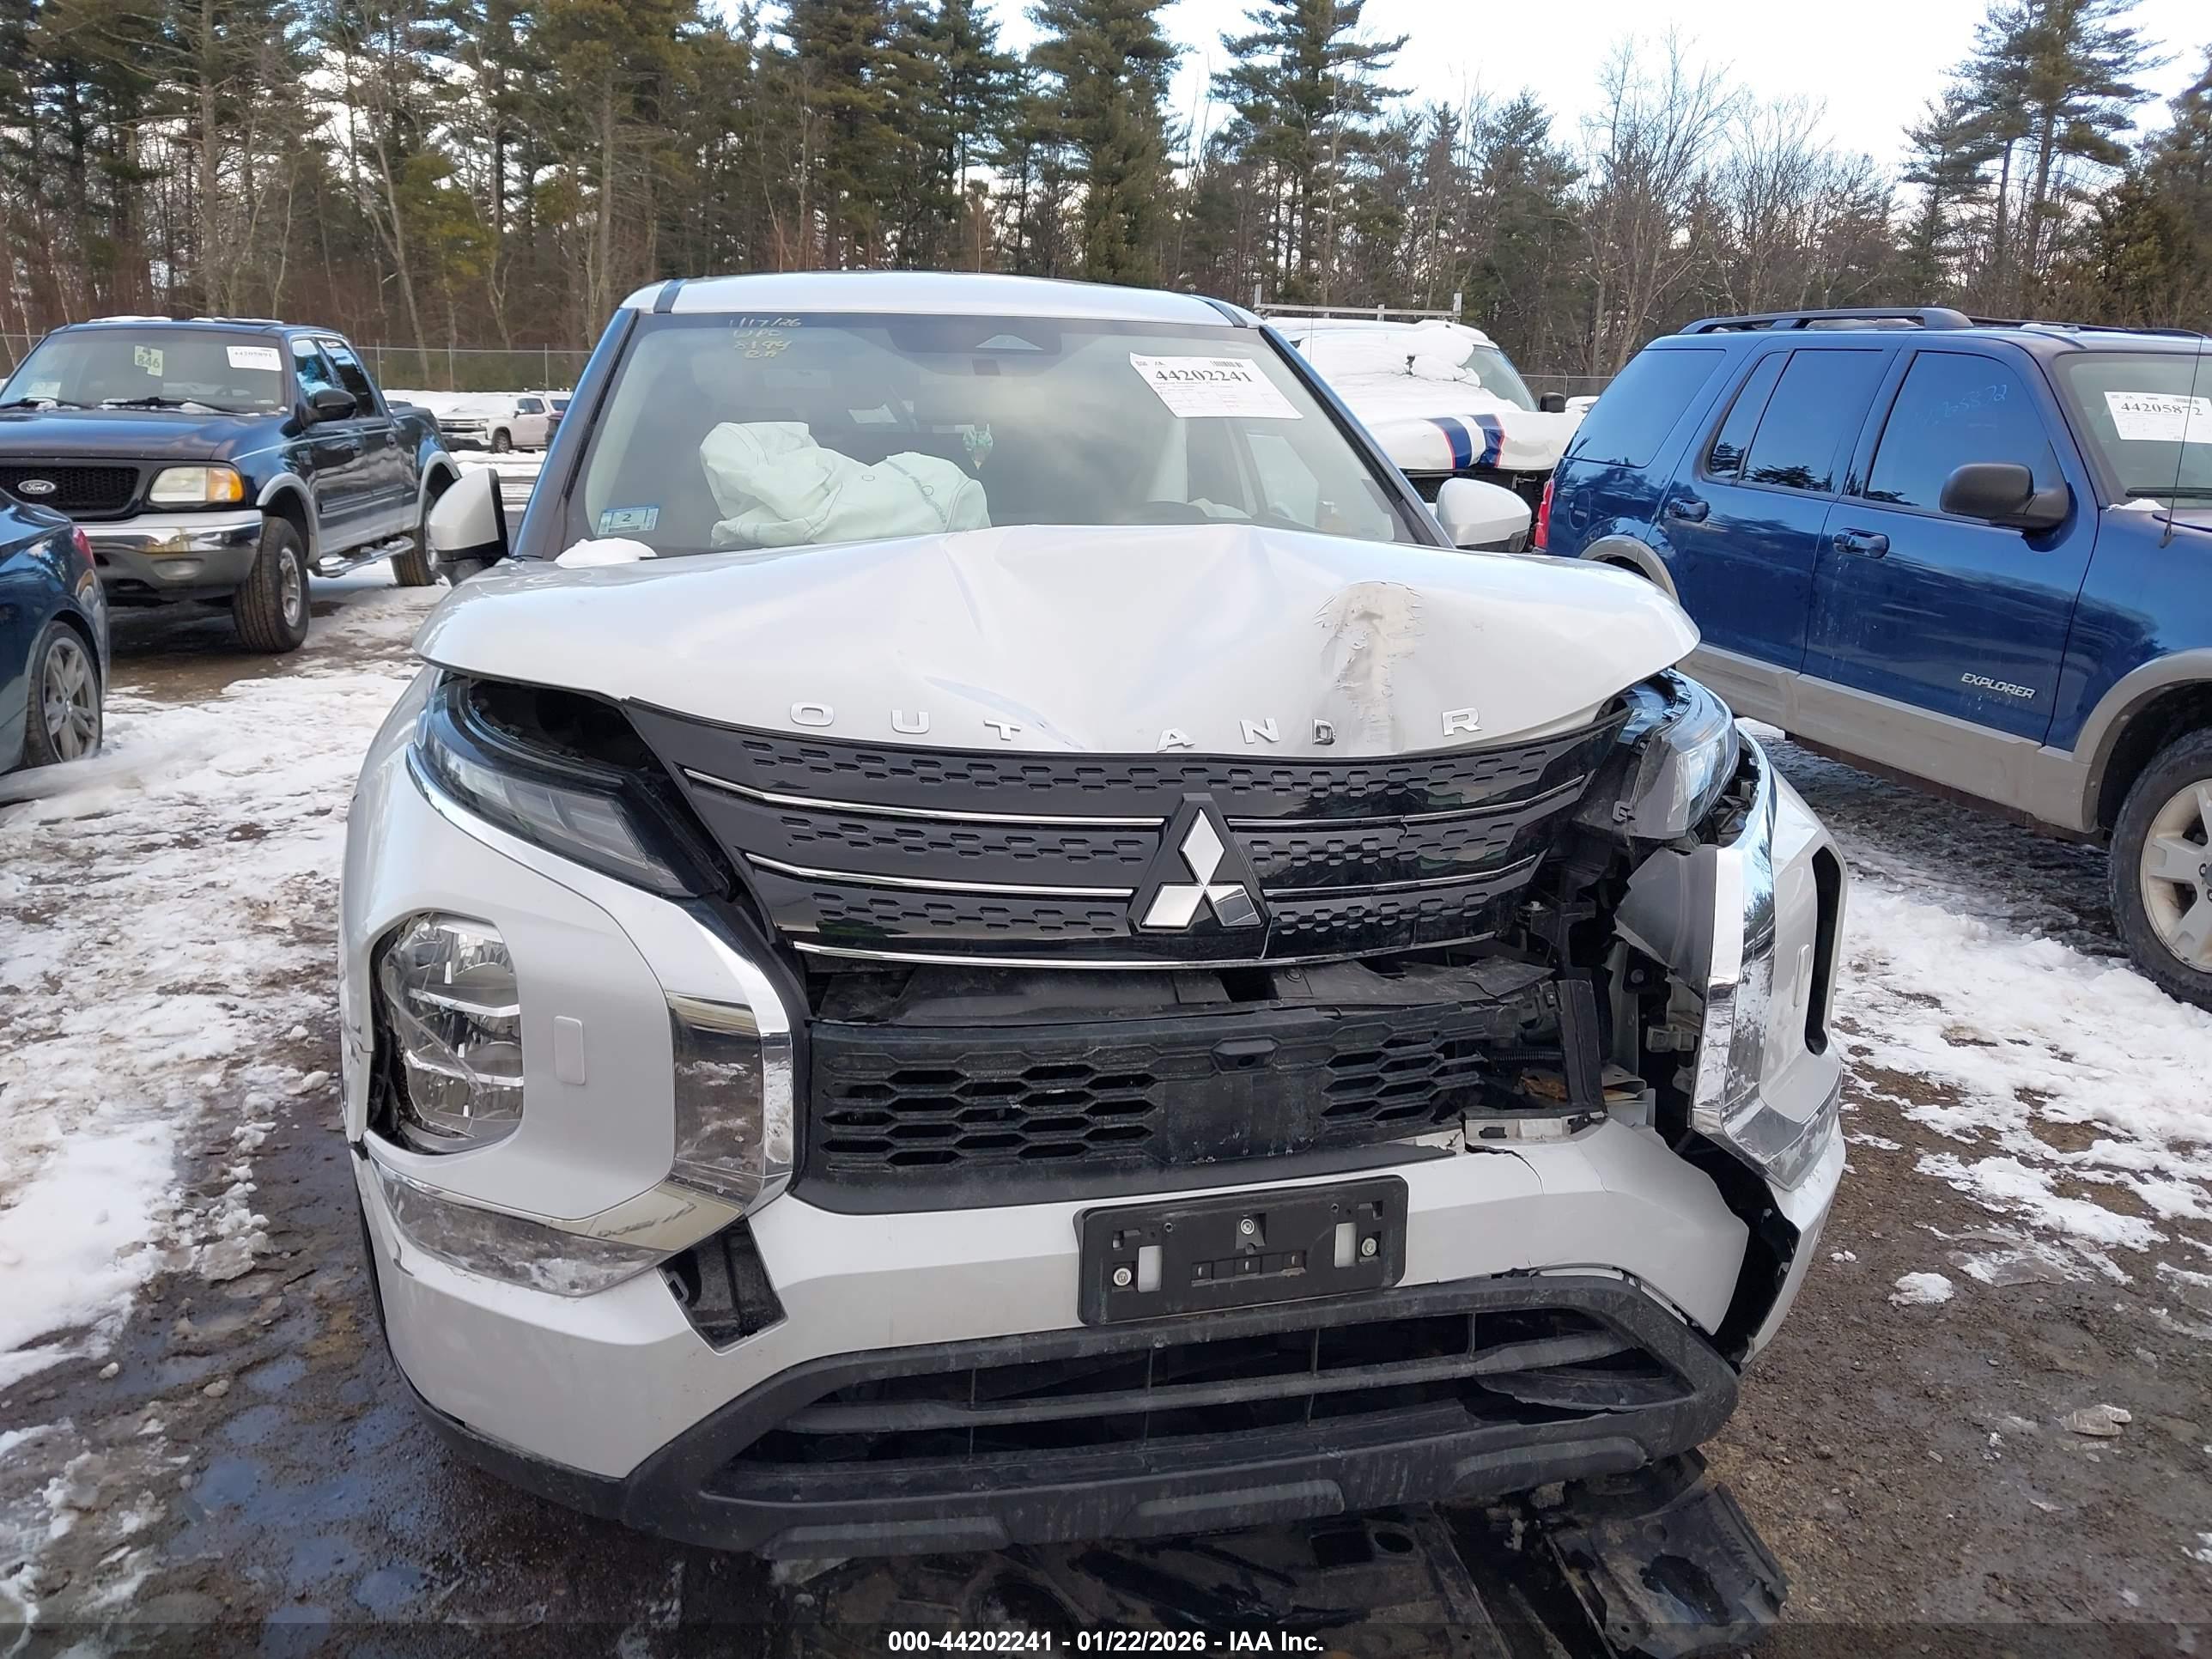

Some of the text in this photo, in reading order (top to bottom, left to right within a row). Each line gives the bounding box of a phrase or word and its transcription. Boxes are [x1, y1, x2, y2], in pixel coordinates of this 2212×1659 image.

[1156, 369, 1255, 383] 44202241
[622, 513, 632, 522] 2
[1961, 672, 2036, 699] EXPLORER
